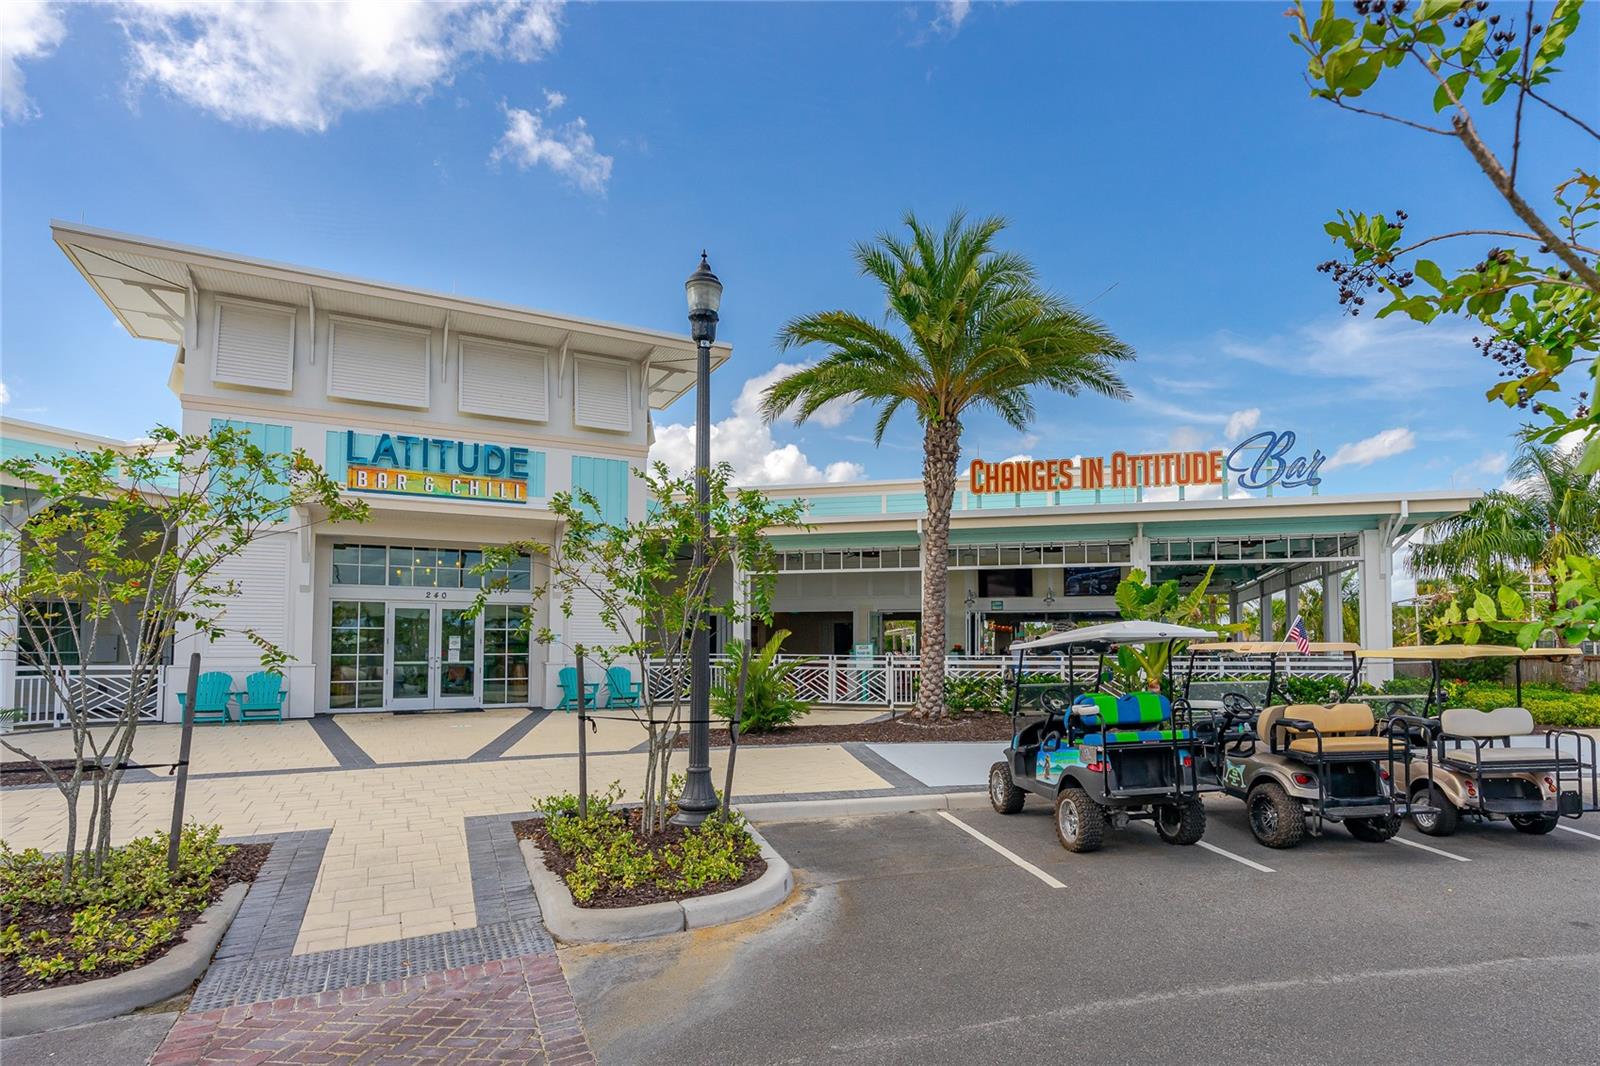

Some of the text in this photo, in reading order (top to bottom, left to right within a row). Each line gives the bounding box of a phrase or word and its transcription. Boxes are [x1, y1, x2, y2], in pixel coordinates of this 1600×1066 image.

[347, 430, 529, 477] LATITUDE
[969, 430, 1326, 495] CHANGES IN ATTITUDE Bar
[357, 470, 523, 499] BAR & CHILL
[425, 591, 447, 599] 240
